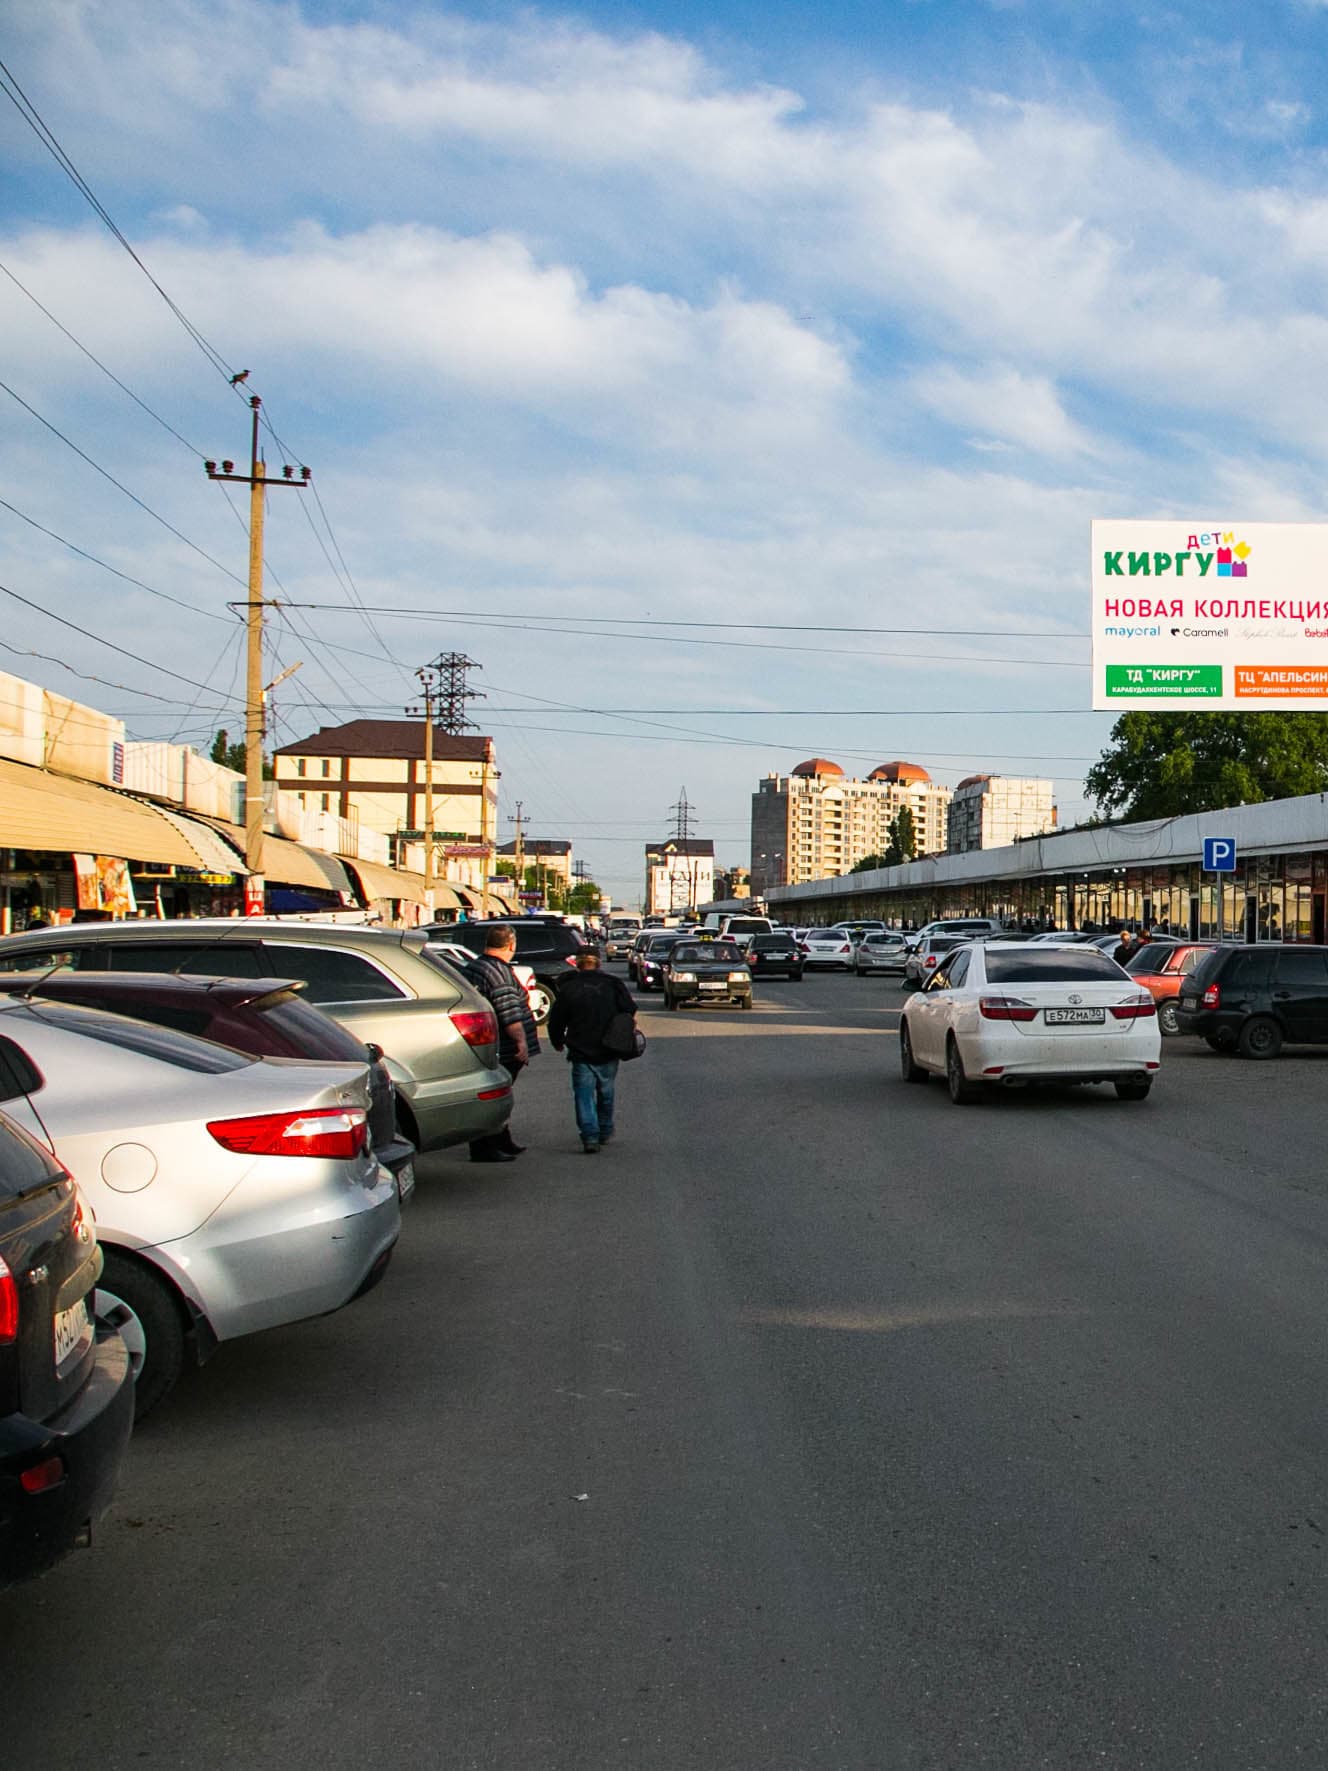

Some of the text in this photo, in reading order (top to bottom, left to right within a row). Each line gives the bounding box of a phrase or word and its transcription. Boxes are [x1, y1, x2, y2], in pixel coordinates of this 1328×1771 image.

[1187, 531, 1235, 550] дети
[1104, 552, 1215, 577] КИРГУ
[1105, 599, 1183, 617] НОВАЯ
[1105, 626, 1160, 638] mayoral
[1183, 628, 1229, 638] Caramell
[1126, 669, 1200, 683] ТД "КИРГУ"
[1238, 672, 1255, 684] ТЦ
[1213, 842, 1230, 867] P
